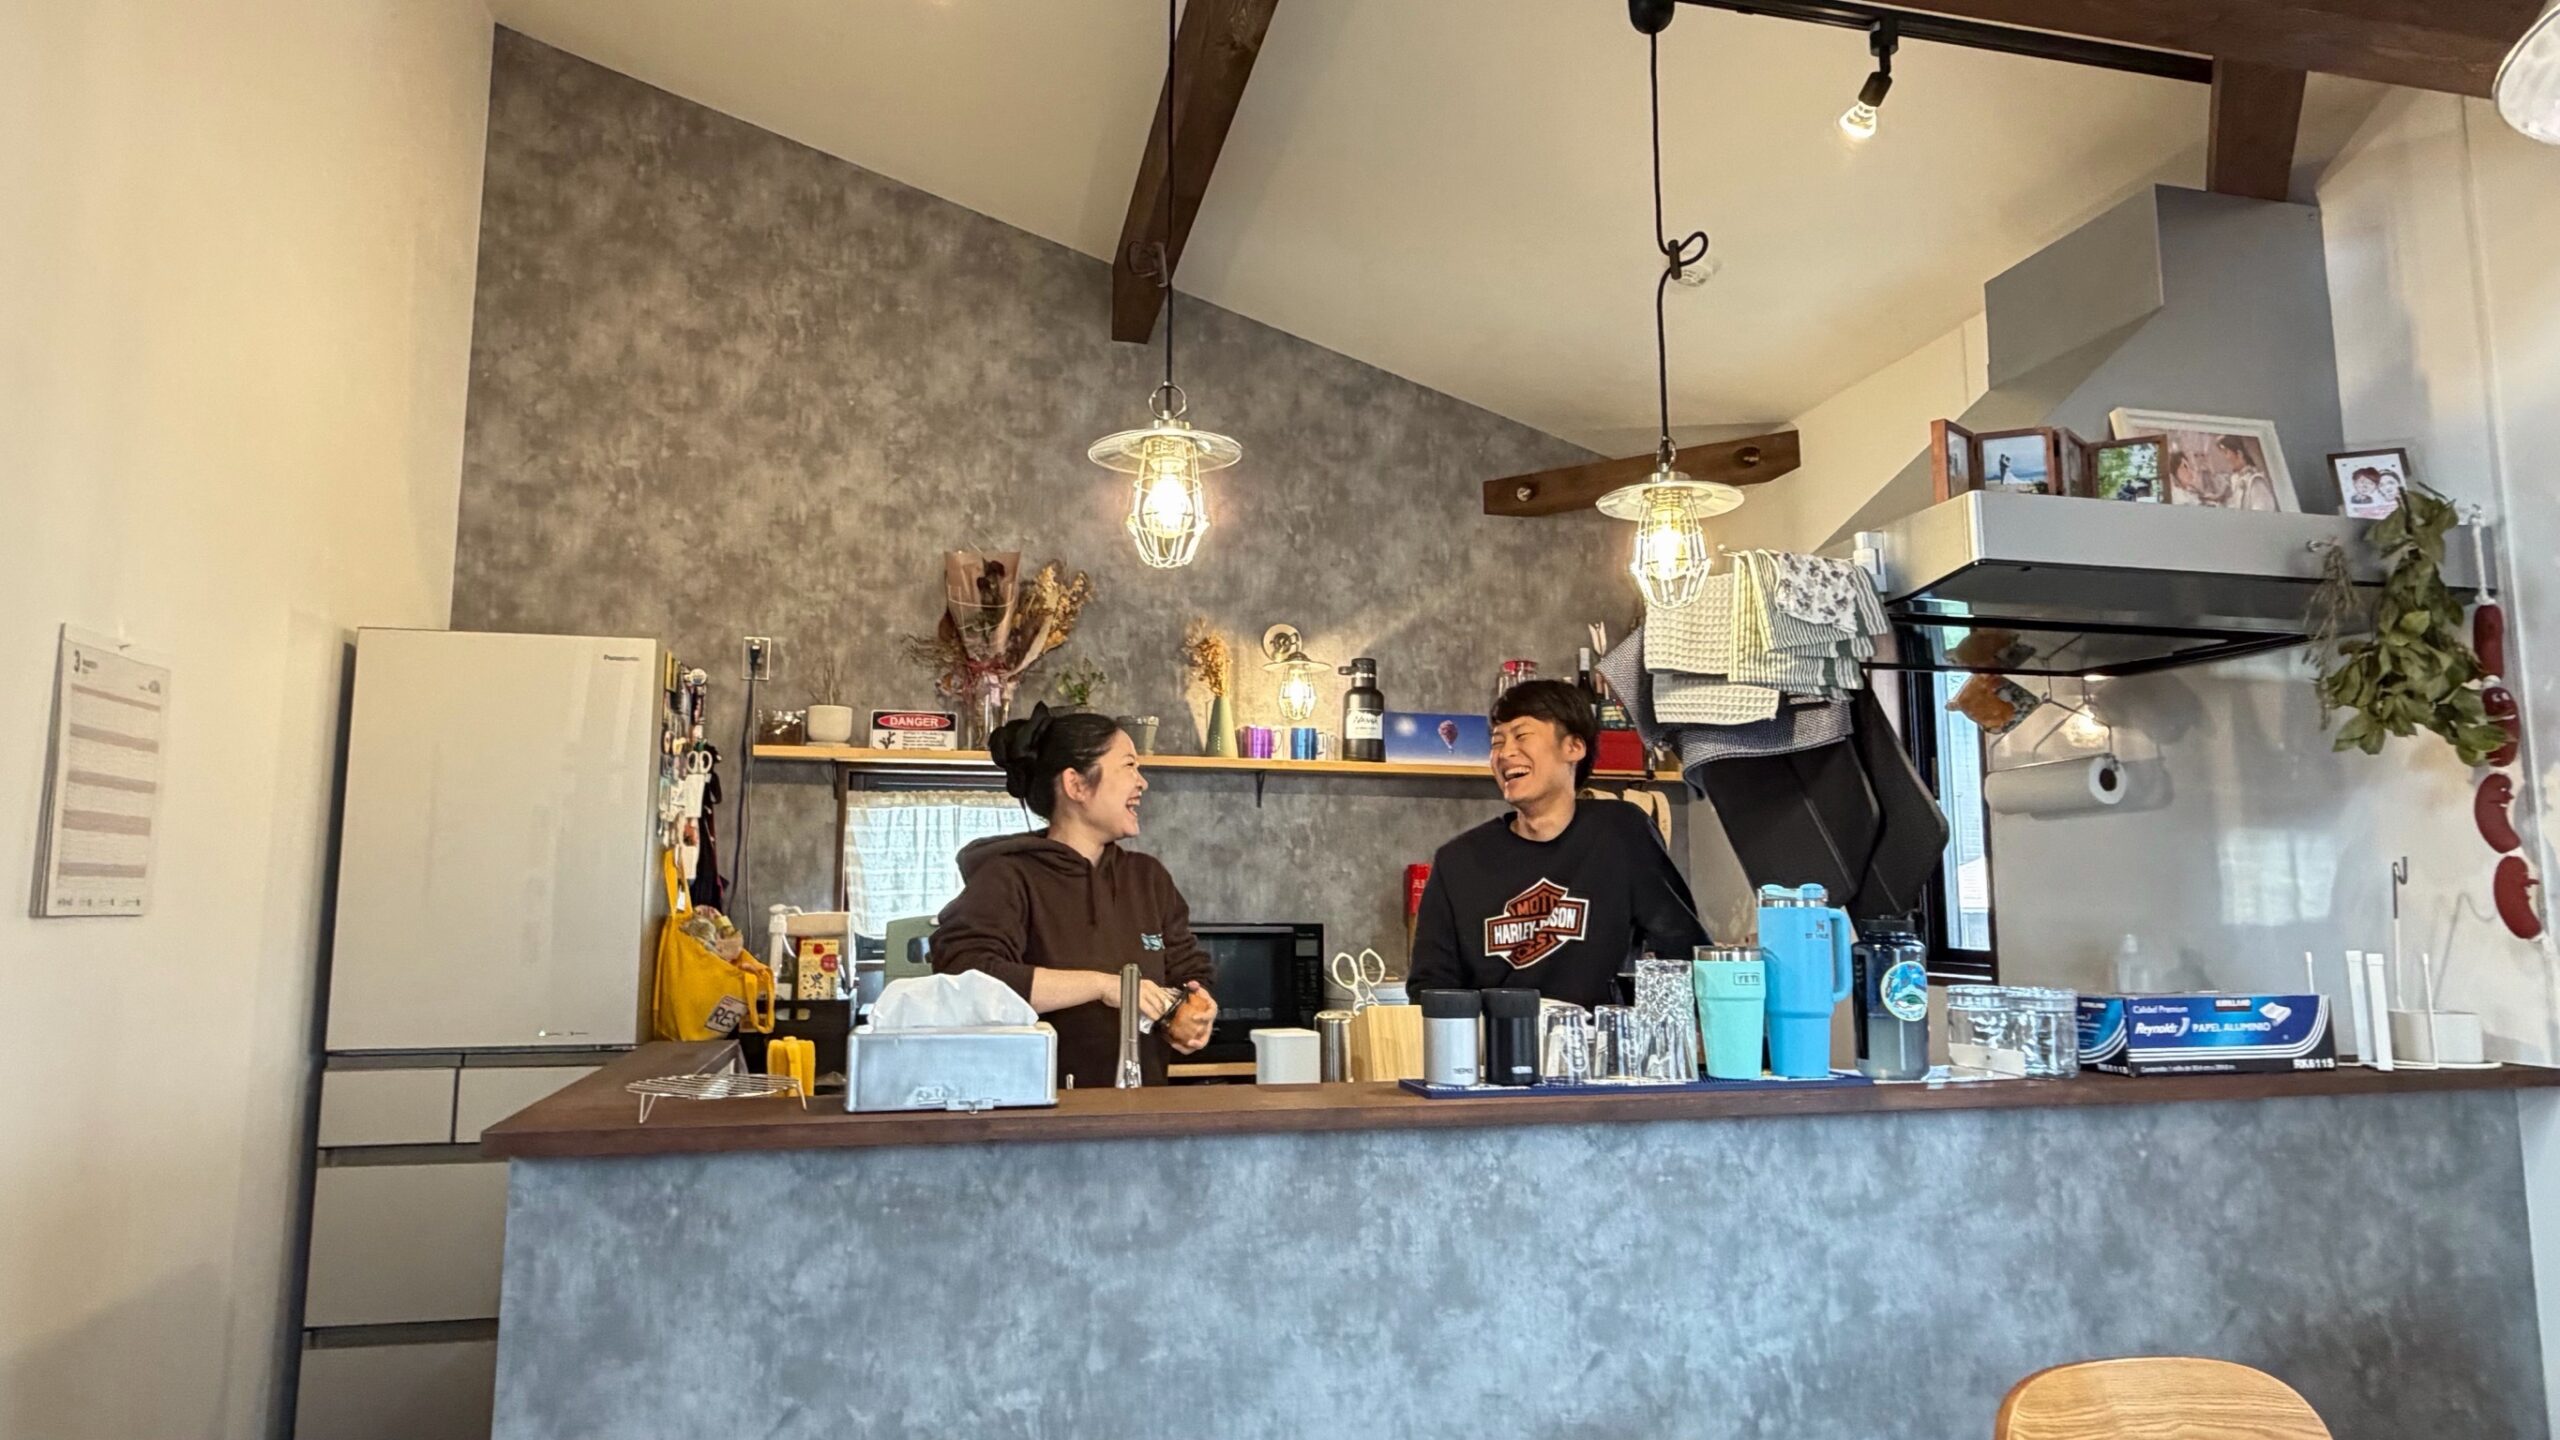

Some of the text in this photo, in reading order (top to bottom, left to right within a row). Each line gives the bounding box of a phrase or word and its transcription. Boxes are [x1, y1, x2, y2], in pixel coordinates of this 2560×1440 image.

[889, 716, 939, 727] DANGER
[1738, 975, 1760, 984] YETI
[2135, 1022, 2179, 1037] Reynolds
[2192, 1022, 2271, 1033] PAPEL ALUMINIO
